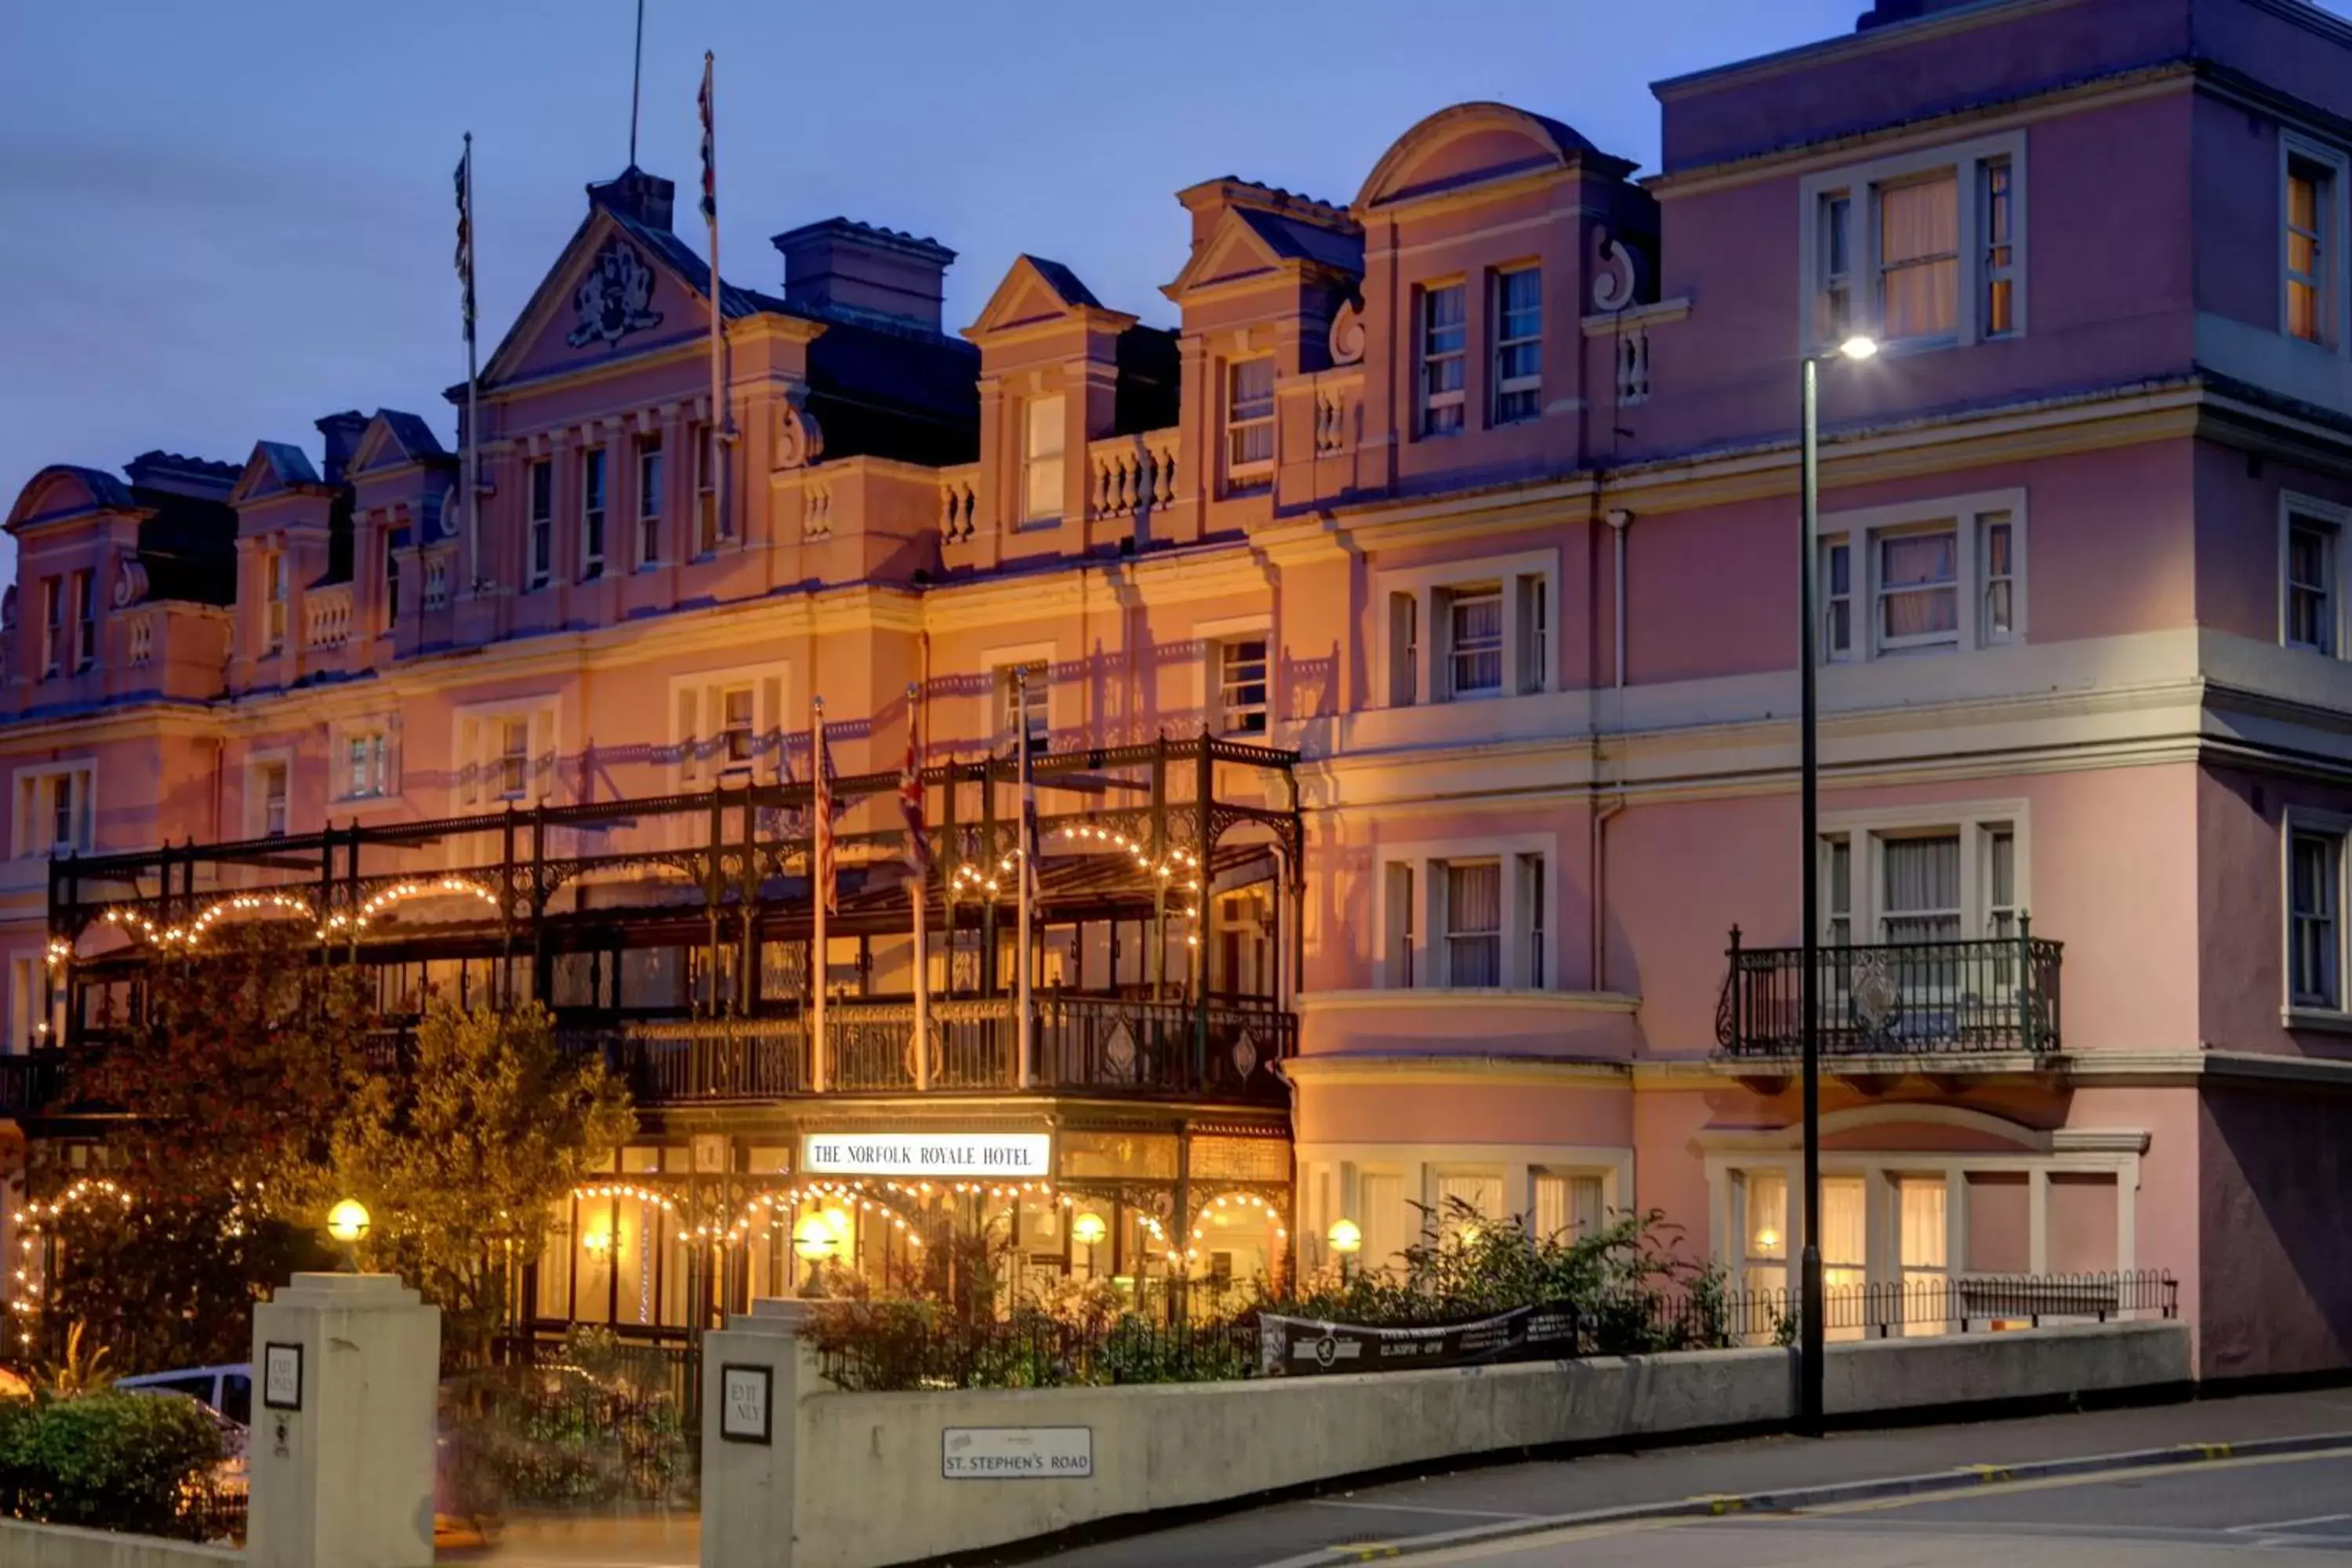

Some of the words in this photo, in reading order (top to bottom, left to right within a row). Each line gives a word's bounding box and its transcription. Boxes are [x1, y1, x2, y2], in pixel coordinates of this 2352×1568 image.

[815, 1145, 840, 1163] THE
[848, 1145, 911, 1164] NORFOLK
[920, 1147, 975, 1164] ROYALE
[983, 1147, 1033, 1166] HOTEL
[735, 1404, 761, 1421] NLY
[946, 1456, 965, 1469] ST.
[970, 1454, 1044, 1469] STEPHEN'S
[1051, 1455, 1088, 1468] ROAD
